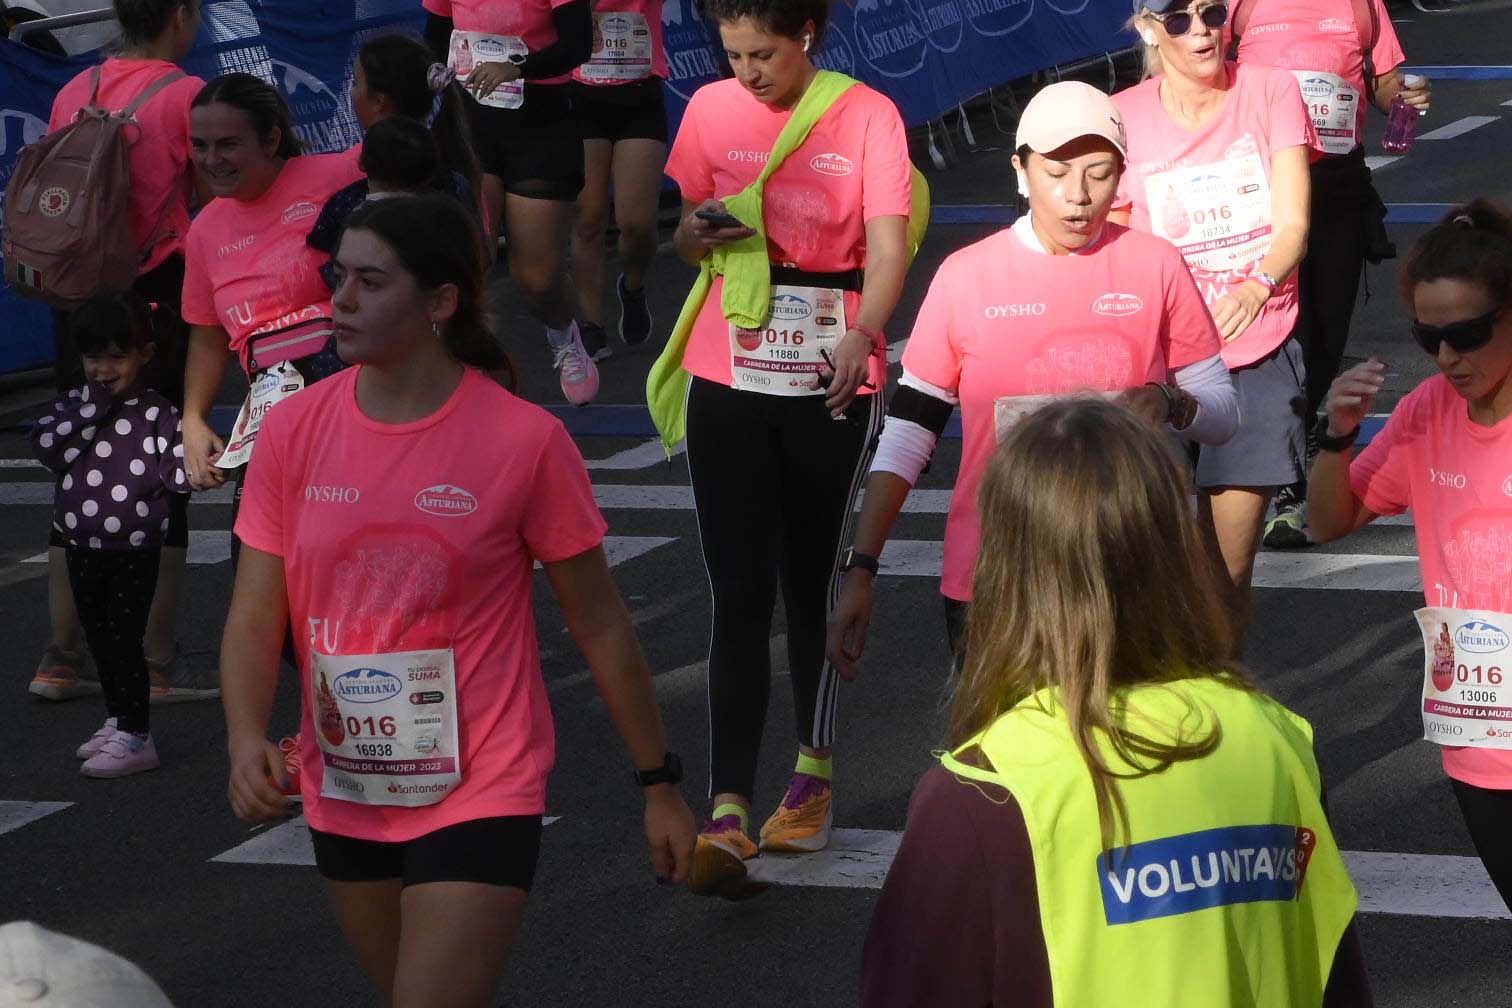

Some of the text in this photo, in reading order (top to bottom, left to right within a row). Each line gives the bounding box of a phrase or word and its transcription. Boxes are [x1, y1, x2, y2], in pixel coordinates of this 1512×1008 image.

[606, 38, 627, 48] 016
[1310, 104, 1329, 115] 16
[812, 159, 852, 172] ASTURIANA
[1193, 205, 1233, 225] 016
[225, 301, 252, 329] TU
[984, 302, 1046, 319] OYSHO
[766, 329, 804, 345] 016
[769, 349, 800, 360] 11880
[743, 360, 770, 369] CARRERA
[781, 362, 790, 370] LA
[792, 363, 816, 371] MUJER
[742, 373, 771, 386] OYSHO
[251, 401, 272, 420] 016
[1429, 469, 1467, 489] YSHO
[418, 493, 473, 512] ASTURIANA
[308, 617, 340, 654] TU
[1459, 632, 1505, 647] ASTURIANA
[408, 671, 441, 682] SUMA
[1457, 663, 1503, 685] 016
[338, 681, 396, 696] ASTURIANA
[1459, 689, 1497, 703] 13006
[1433, 703, 1461, 715] CARRERA
[1462, 708, 1474, 716] DE
[1475, 708, 1486, 716] LA
[346, 715, 397, 737] 016
[1429, 721, 1463, 736] OYSHO
[354, 743, 393, 757] 16938
[332, 758, 361, 771] CARRERA
[362, 763, 373, 771] DE
[387, 763, 416, 772] MUJER
[420, 762, 441, 771] 2023
[397, 783, 449, 794] Santander
